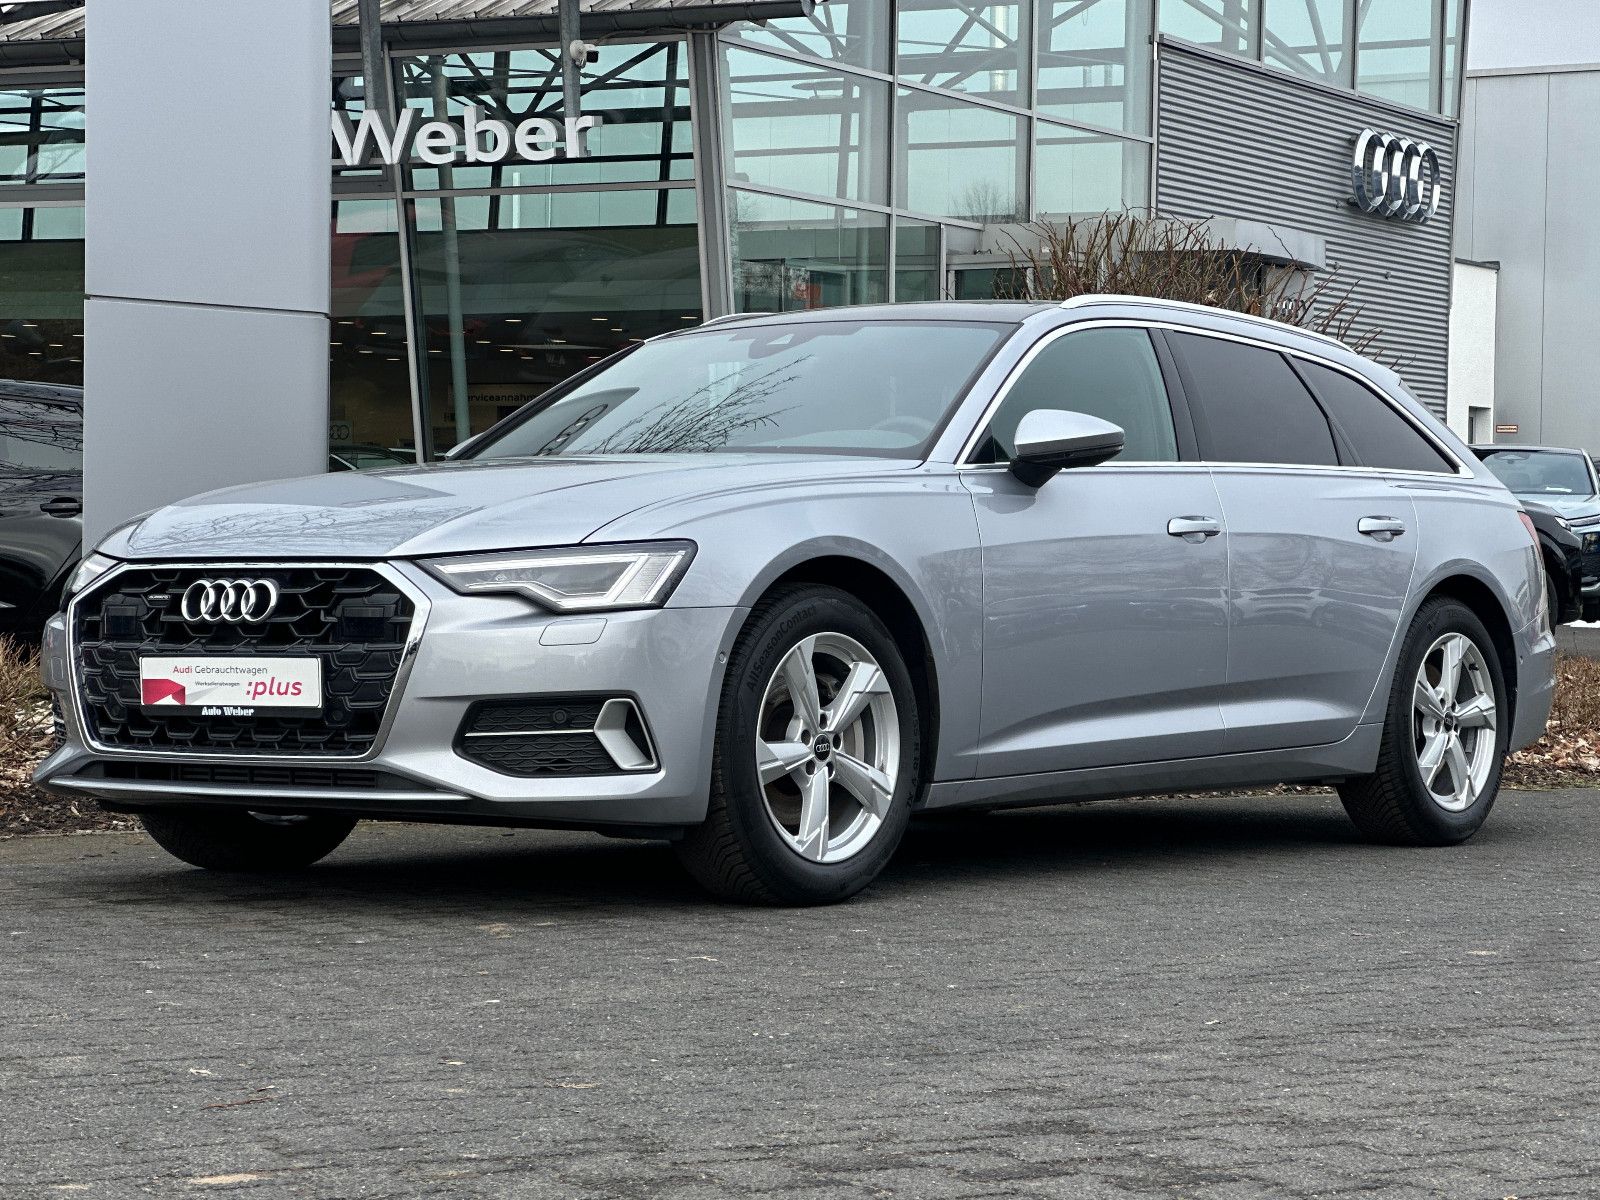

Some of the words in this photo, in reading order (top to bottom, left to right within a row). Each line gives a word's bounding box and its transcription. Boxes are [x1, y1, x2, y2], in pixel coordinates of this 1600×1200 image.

[331, 105, 602, 166] Weber
[746, 603, 818, 693] AllSeasonContact
[172, 665, 193, 674] Audi
[194, 665, 268, 676] Gebrauchtwagen
[201, 706, 222, 716] Auto
[222, 706, 254, 716] Weber
